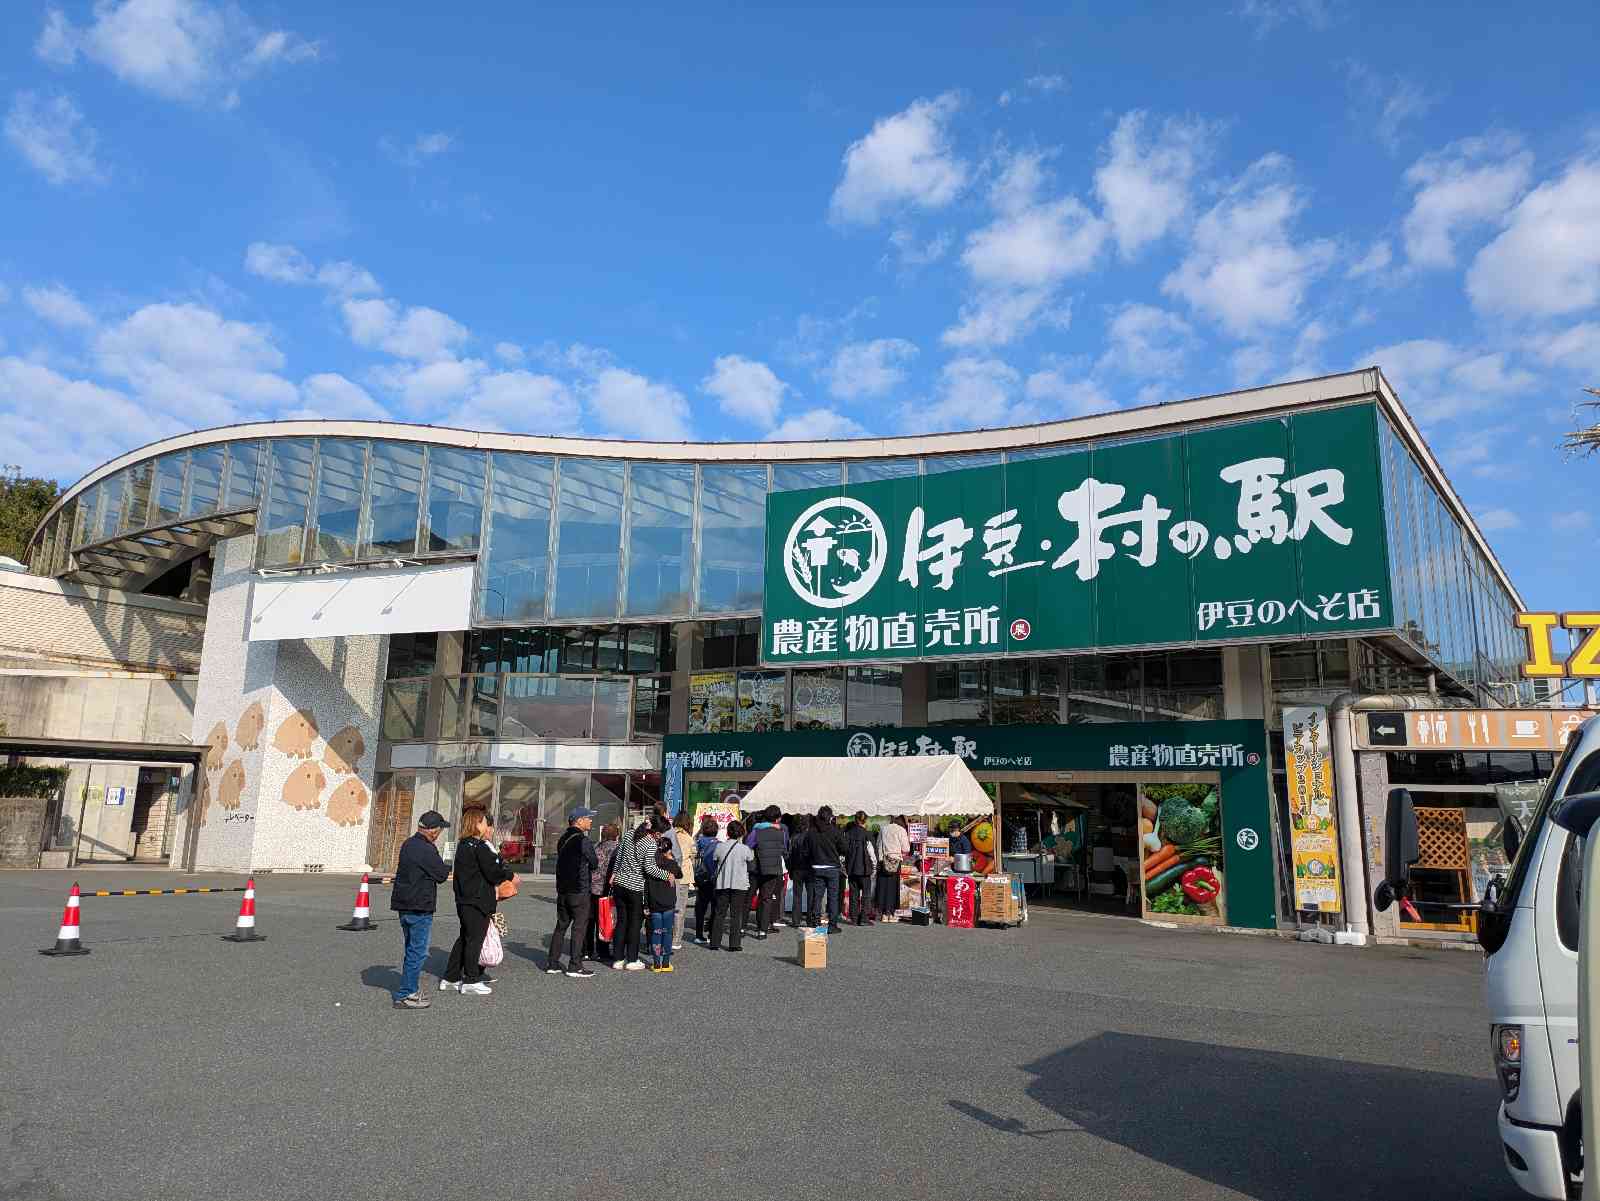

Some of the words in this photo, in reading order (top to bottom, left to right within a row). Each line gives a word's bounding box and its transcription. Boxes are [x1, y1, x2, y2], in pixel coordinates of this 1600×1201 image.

[1197, 588, 1382, 632] 伊豆のへそ店
[771, 605, 1000, 656] 農産物直売所
[983, 756, 1032, 766] 伊豆のへそ店
[1108, 743, 1245, 767] 農産物直売所
